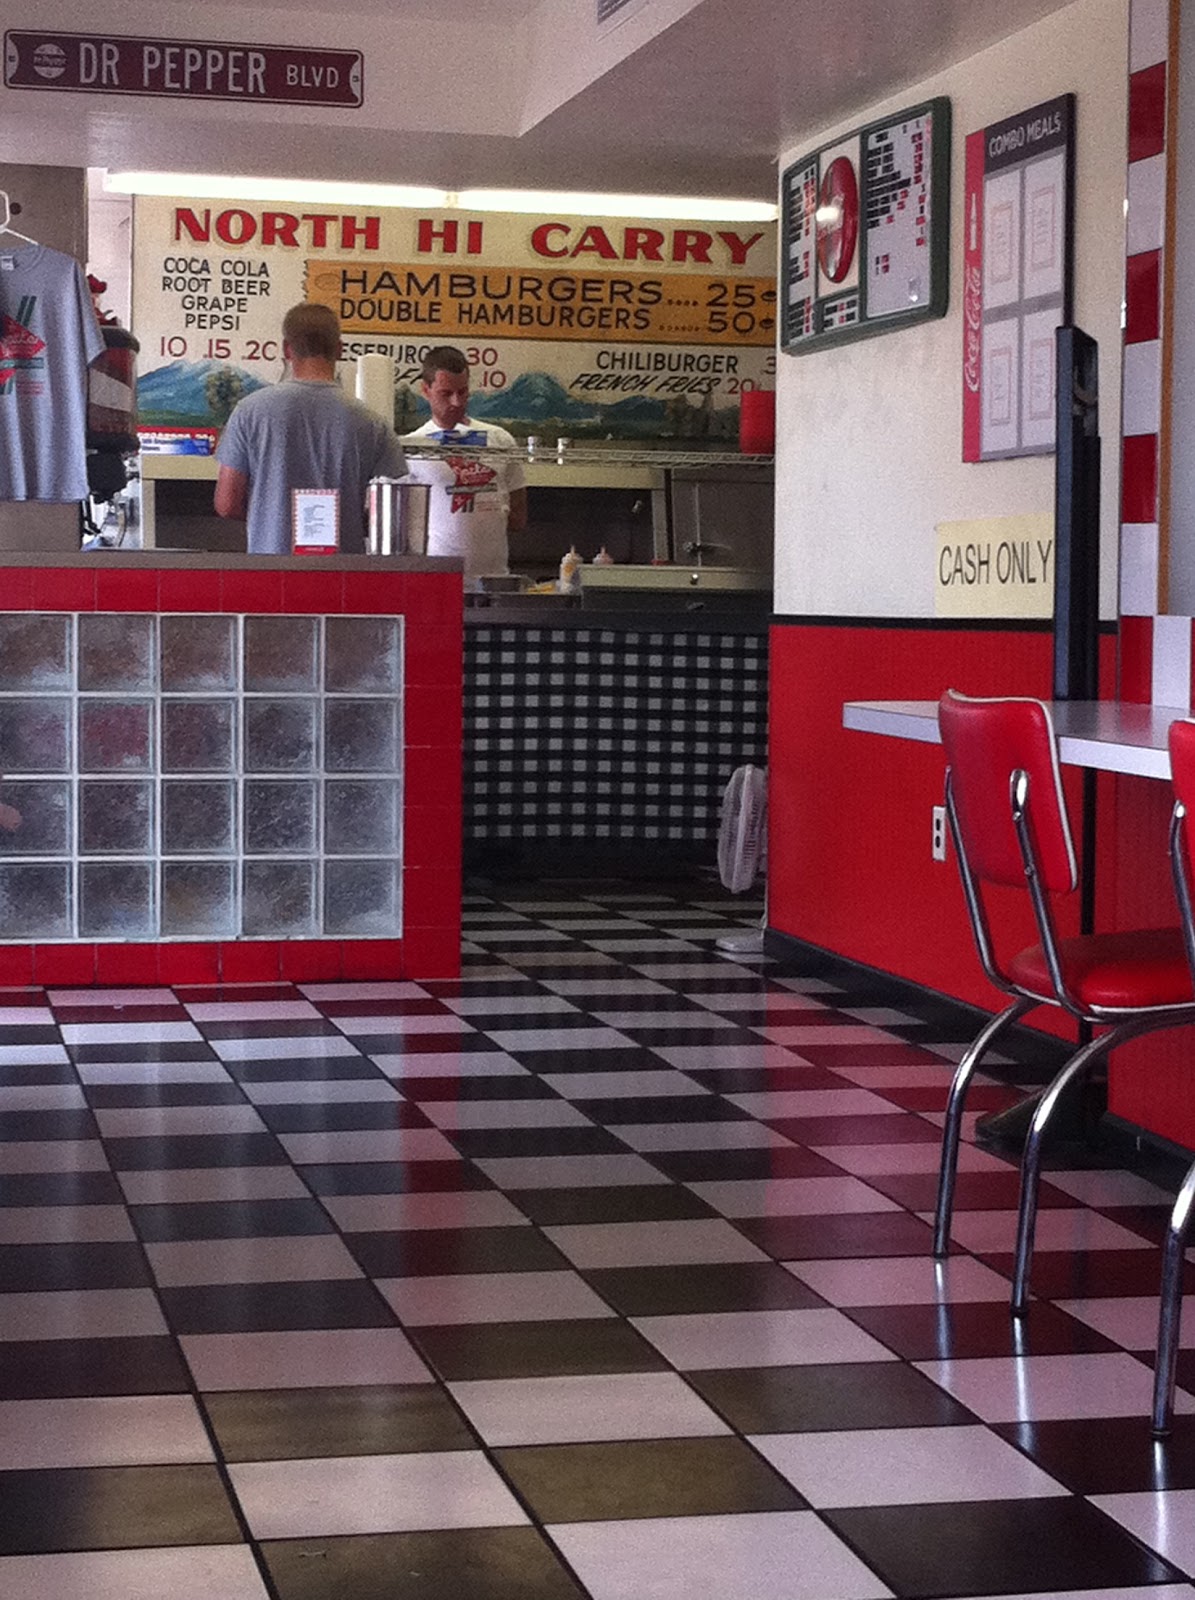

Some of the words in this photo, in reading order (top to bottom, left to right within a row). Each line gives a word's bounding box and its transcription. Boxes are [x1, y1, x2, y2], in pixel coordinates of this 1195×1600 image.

[79, 43, 120, 85] DR
[142, 46, 267, 94] PEPPER
[286, 65, 340, 88] BLVD
[989, 127, 1024, 158] COMBO
[1027, 112, 1061, 143] MEALS
[175, 208, 380, 250] NORTH
[418, 219, 483, 254] HI
[531, 223, 765, 265] CARRY
[164, 257, 211, 275] COCA
[221, 260, 269, 277] COLA
[162, 276, 211, 293] ROOT
[222, 279, 270, 296] BEER
[341, 270, 662, 306] HAMBURGERS
[181, 296, 248, 313] GRAPE
[340, 299, 442, 323] DOUBLE
[458, 303, 650, 330] HAMBURGERS
[185, 314, 240, 331] PEPSI
[596, 351, 738, 373] CHILIBURGER
[569, 373, 658, 392] FRENCH
[655, 374, 721, 395] FRIES
[939, 543, 991, 586] CASH
[996, 540, 1052, 584] ONLY
